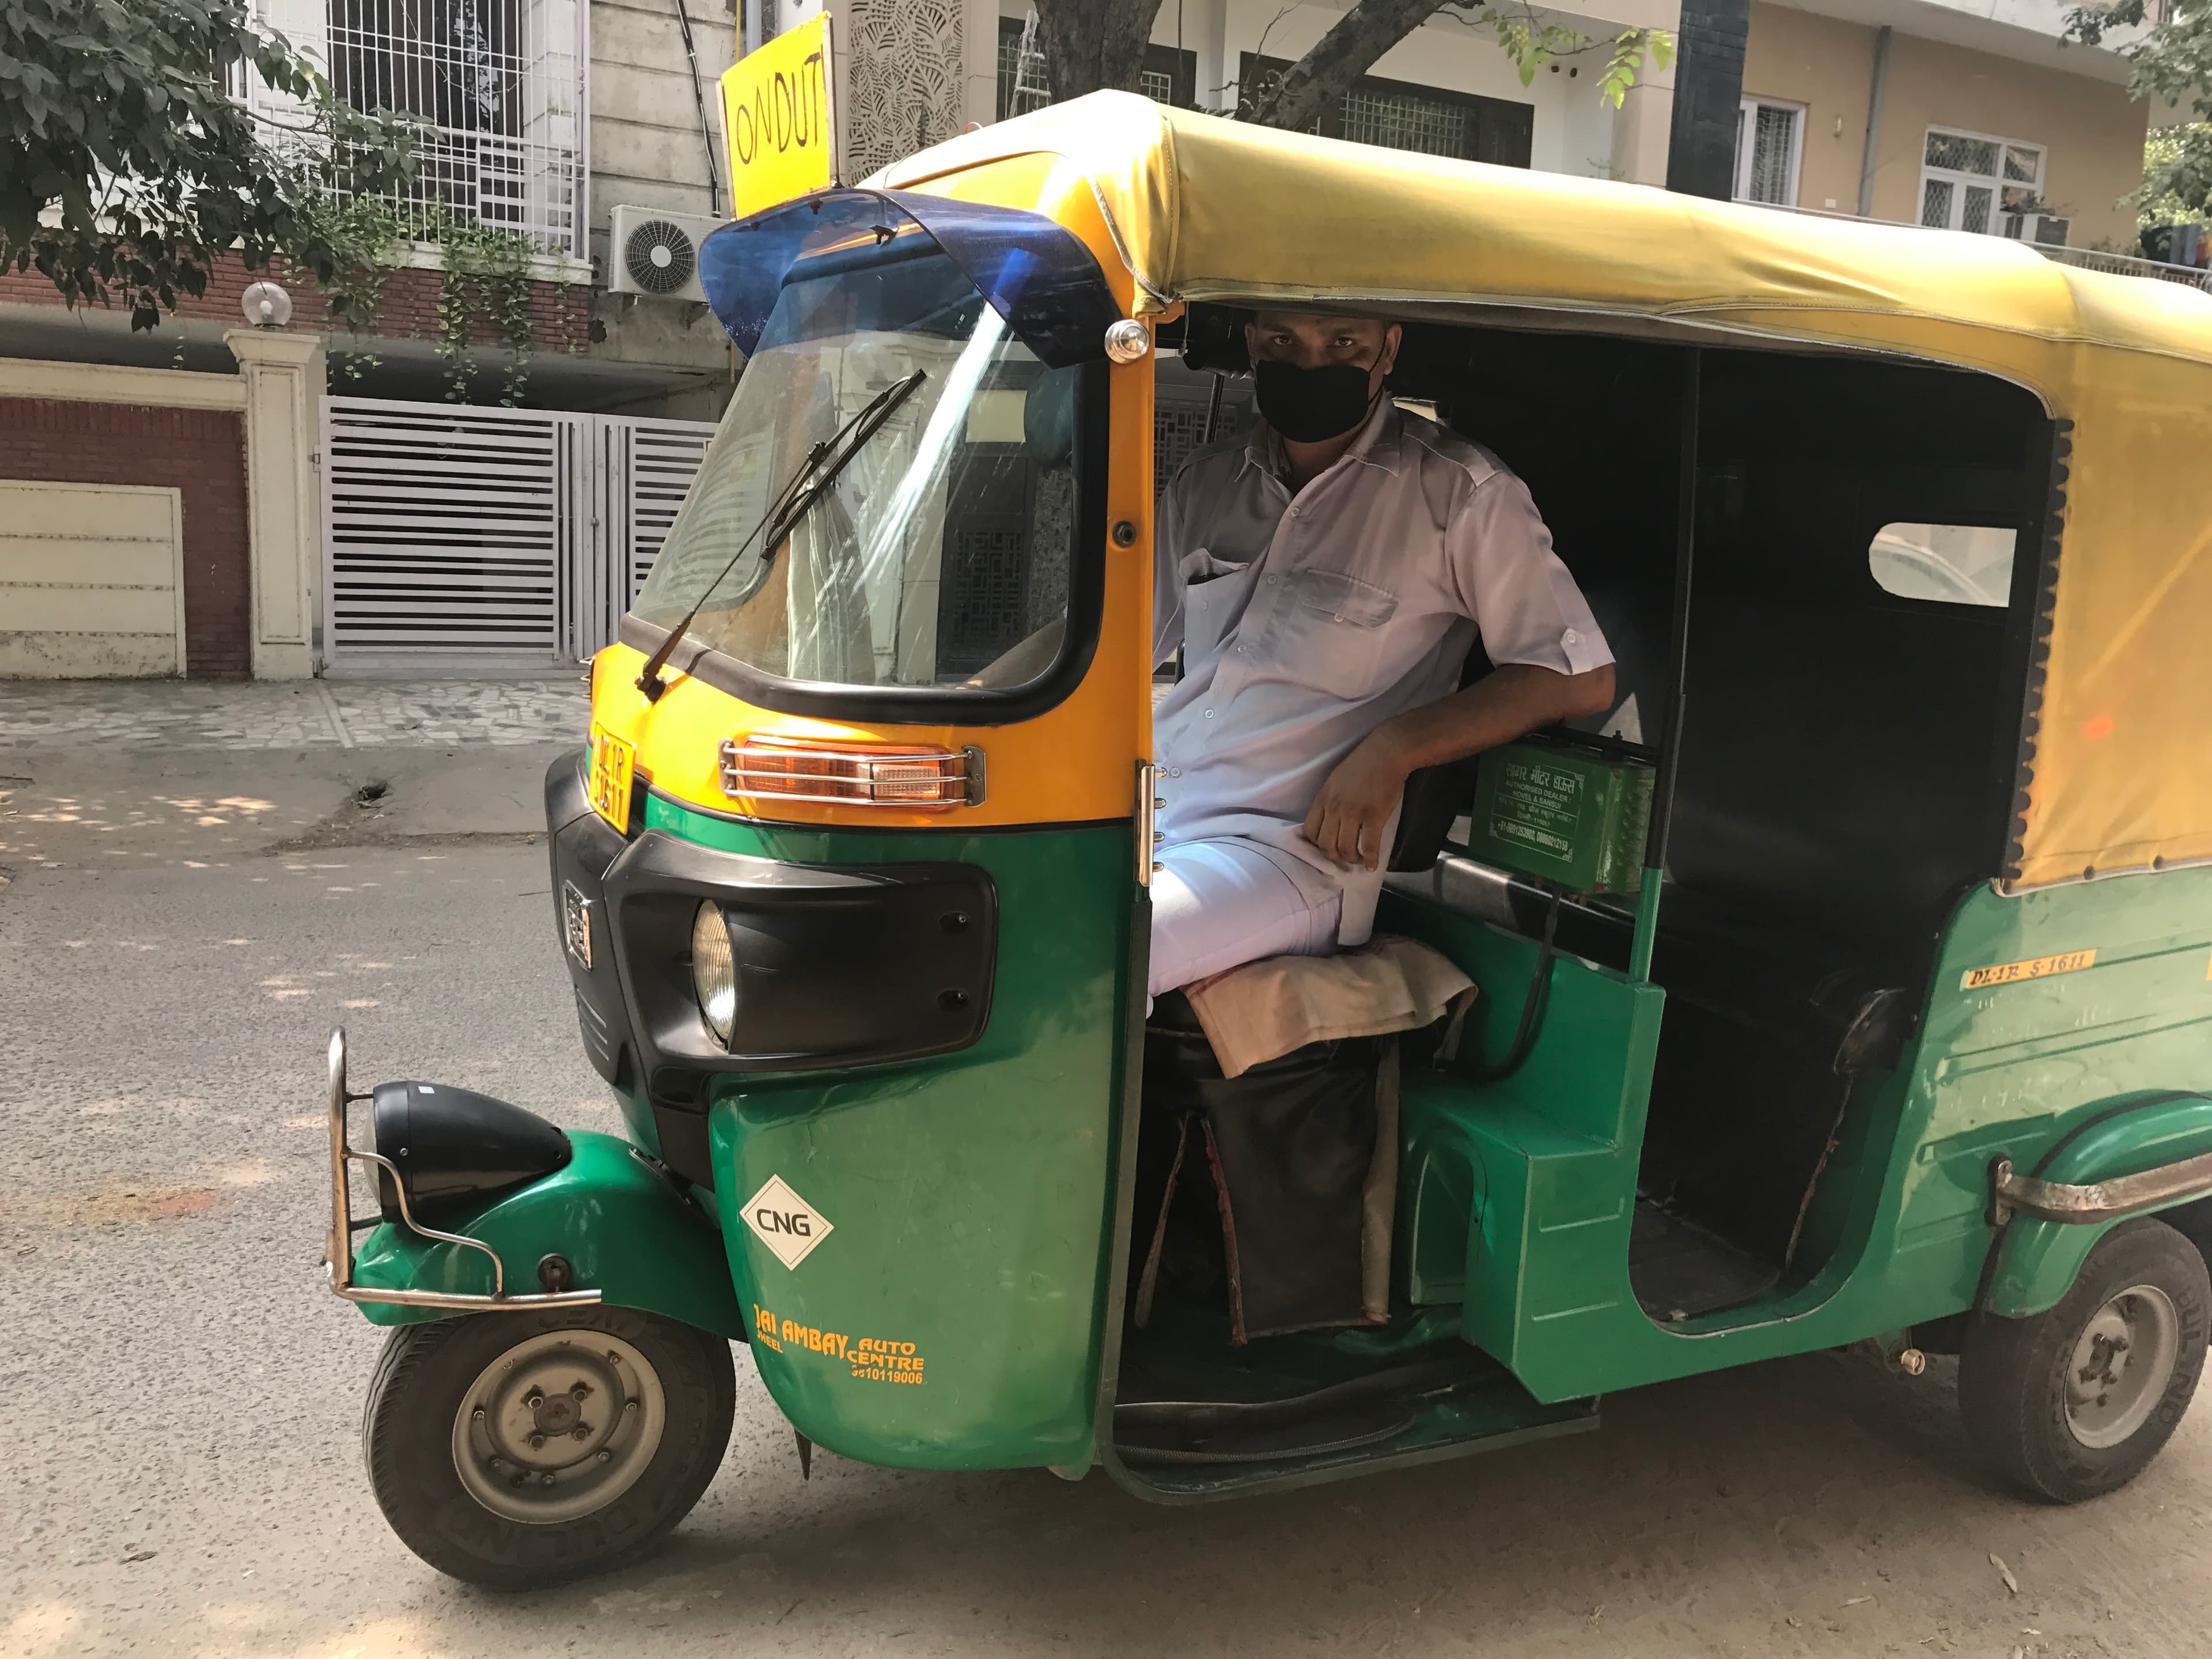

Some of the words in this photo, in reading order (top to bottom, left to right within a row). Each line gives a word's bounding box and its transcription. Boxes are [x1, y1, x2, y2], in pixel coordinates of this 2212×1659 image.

[1505, 779, 1543, 795] AUTHORISED
[756, 1209, 811, 1237] CNG
[753, 1303, 777, 1335] JAI
[782, 1319, 849, 1359] AMBAY
[858, 1338, 916, 1355] AUTO
[847, 1350, 925, 1372] CENTRE
